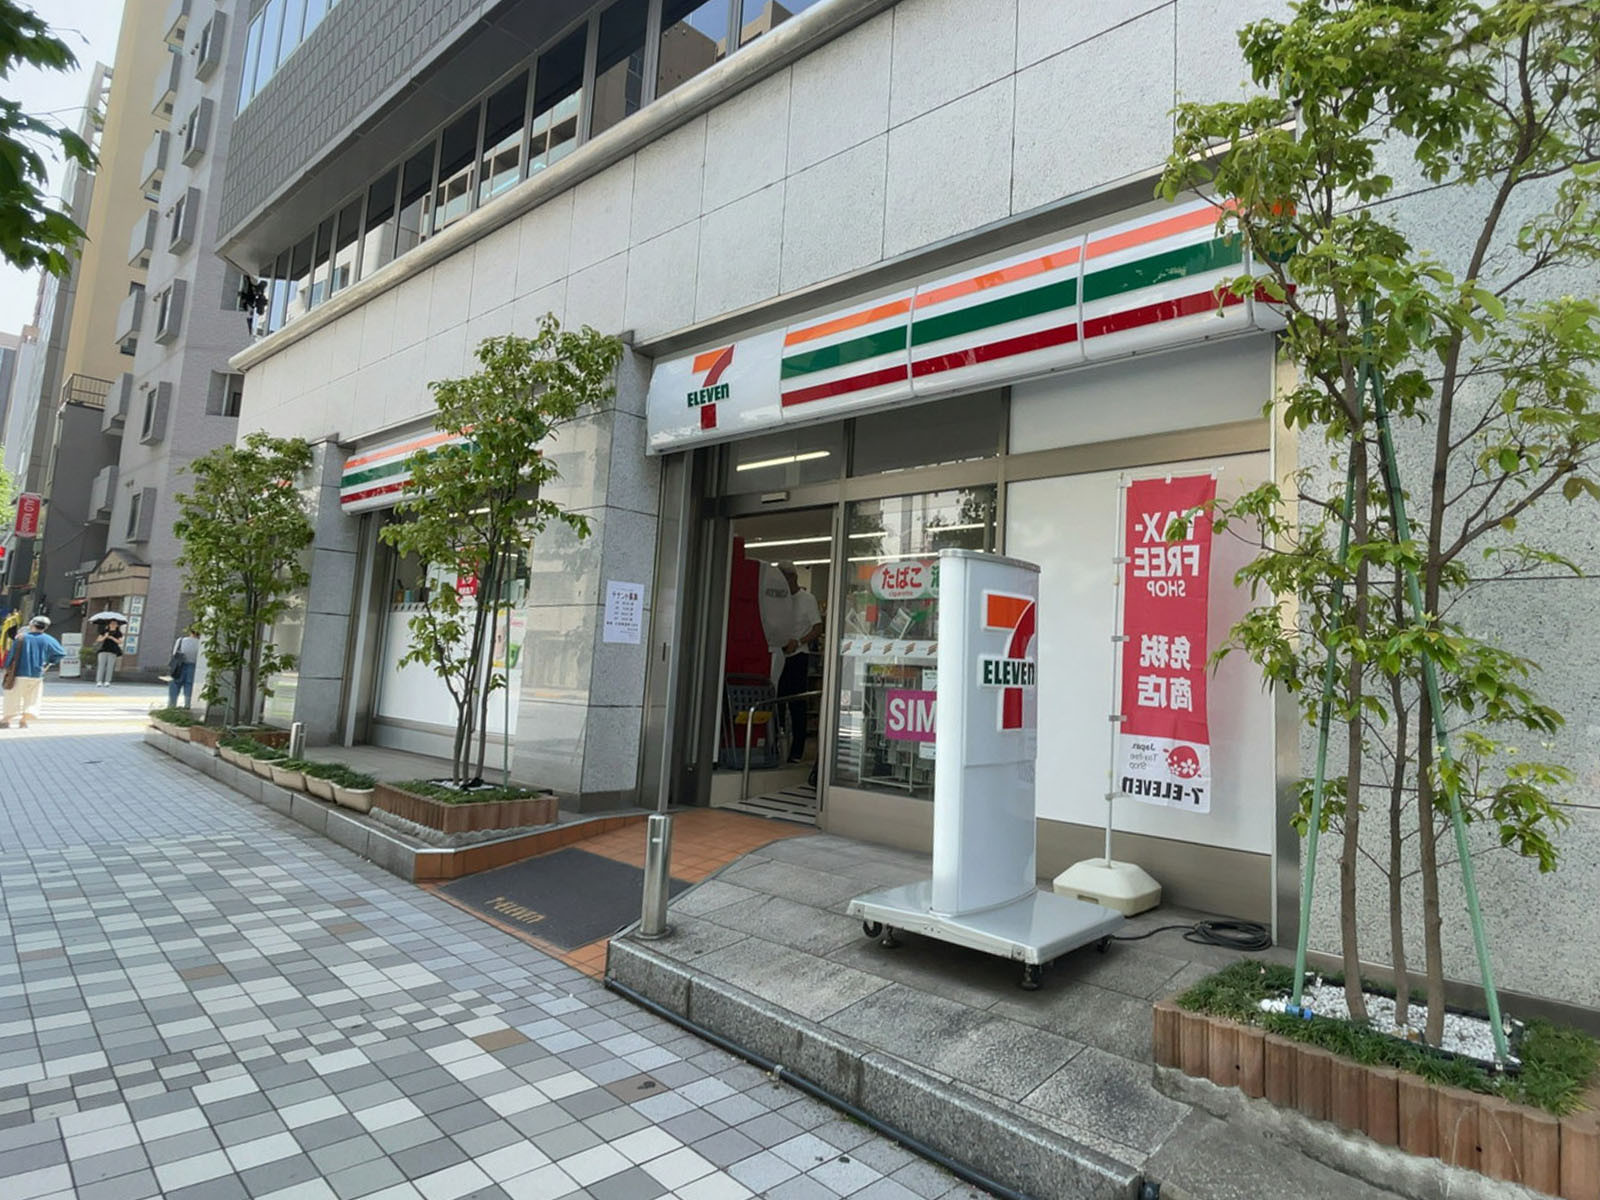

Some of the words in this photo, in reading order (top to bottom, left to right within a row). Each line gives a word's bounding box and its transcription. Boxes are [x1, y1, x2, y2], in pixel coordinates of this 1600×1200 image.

[692, 344, 735, 430] 7
[882, 565, 922, 589] たばこ
[986, 593, 1036, 730] 7
[888, 697, 937, 734] SIM
